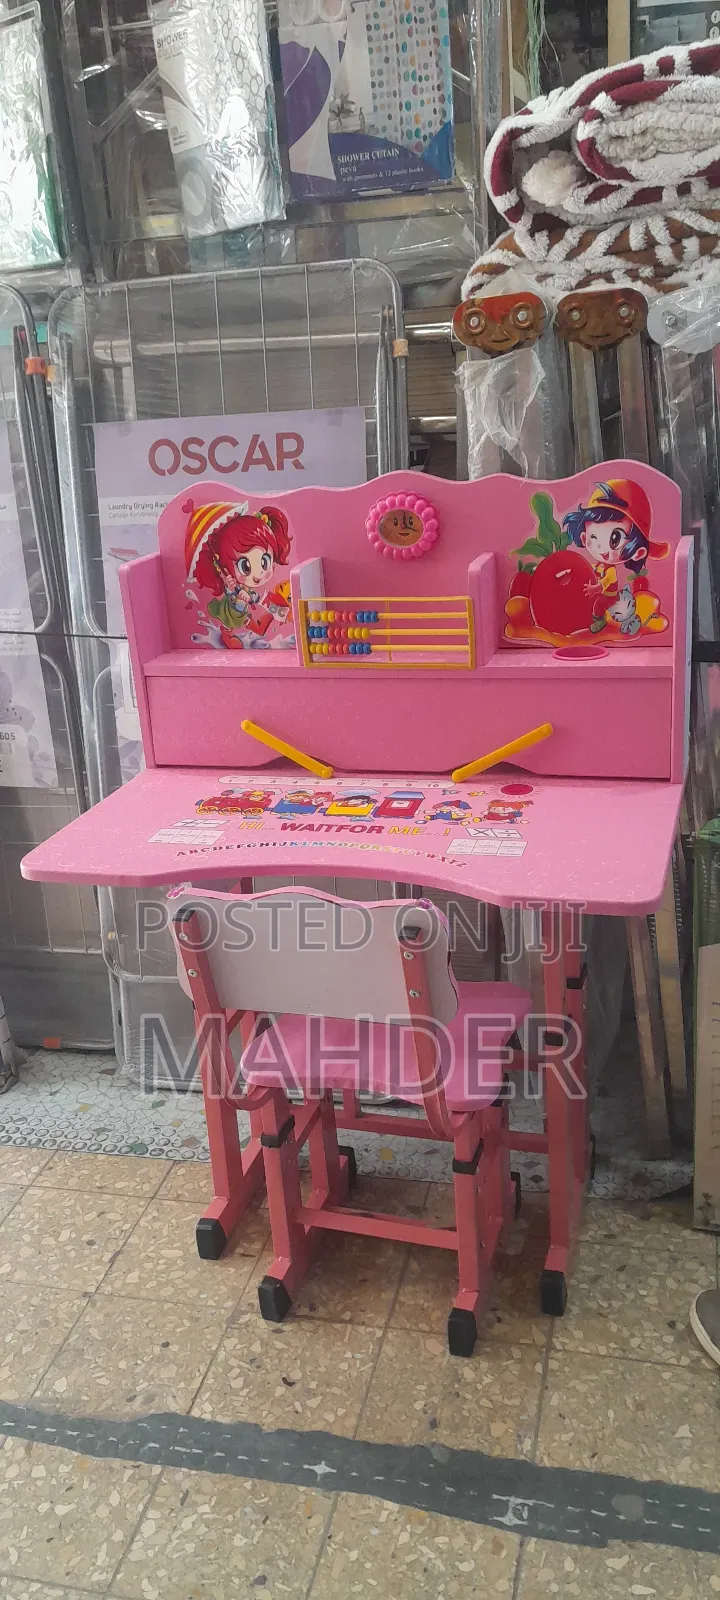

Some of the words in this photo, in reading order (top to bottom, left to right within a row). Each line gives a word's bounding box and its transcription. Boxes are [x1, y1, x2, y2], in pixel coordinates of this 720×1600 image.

[337, 152, 370, 163] SHOWER
[372, 148, 400, 160] CUTAIN
[340, 166, 356, 175] peva
[148, 432, 305, 476] OSCAR
[133, 502, 153, 510] Drying
[281, 823, 385, 834] WAITFOR
